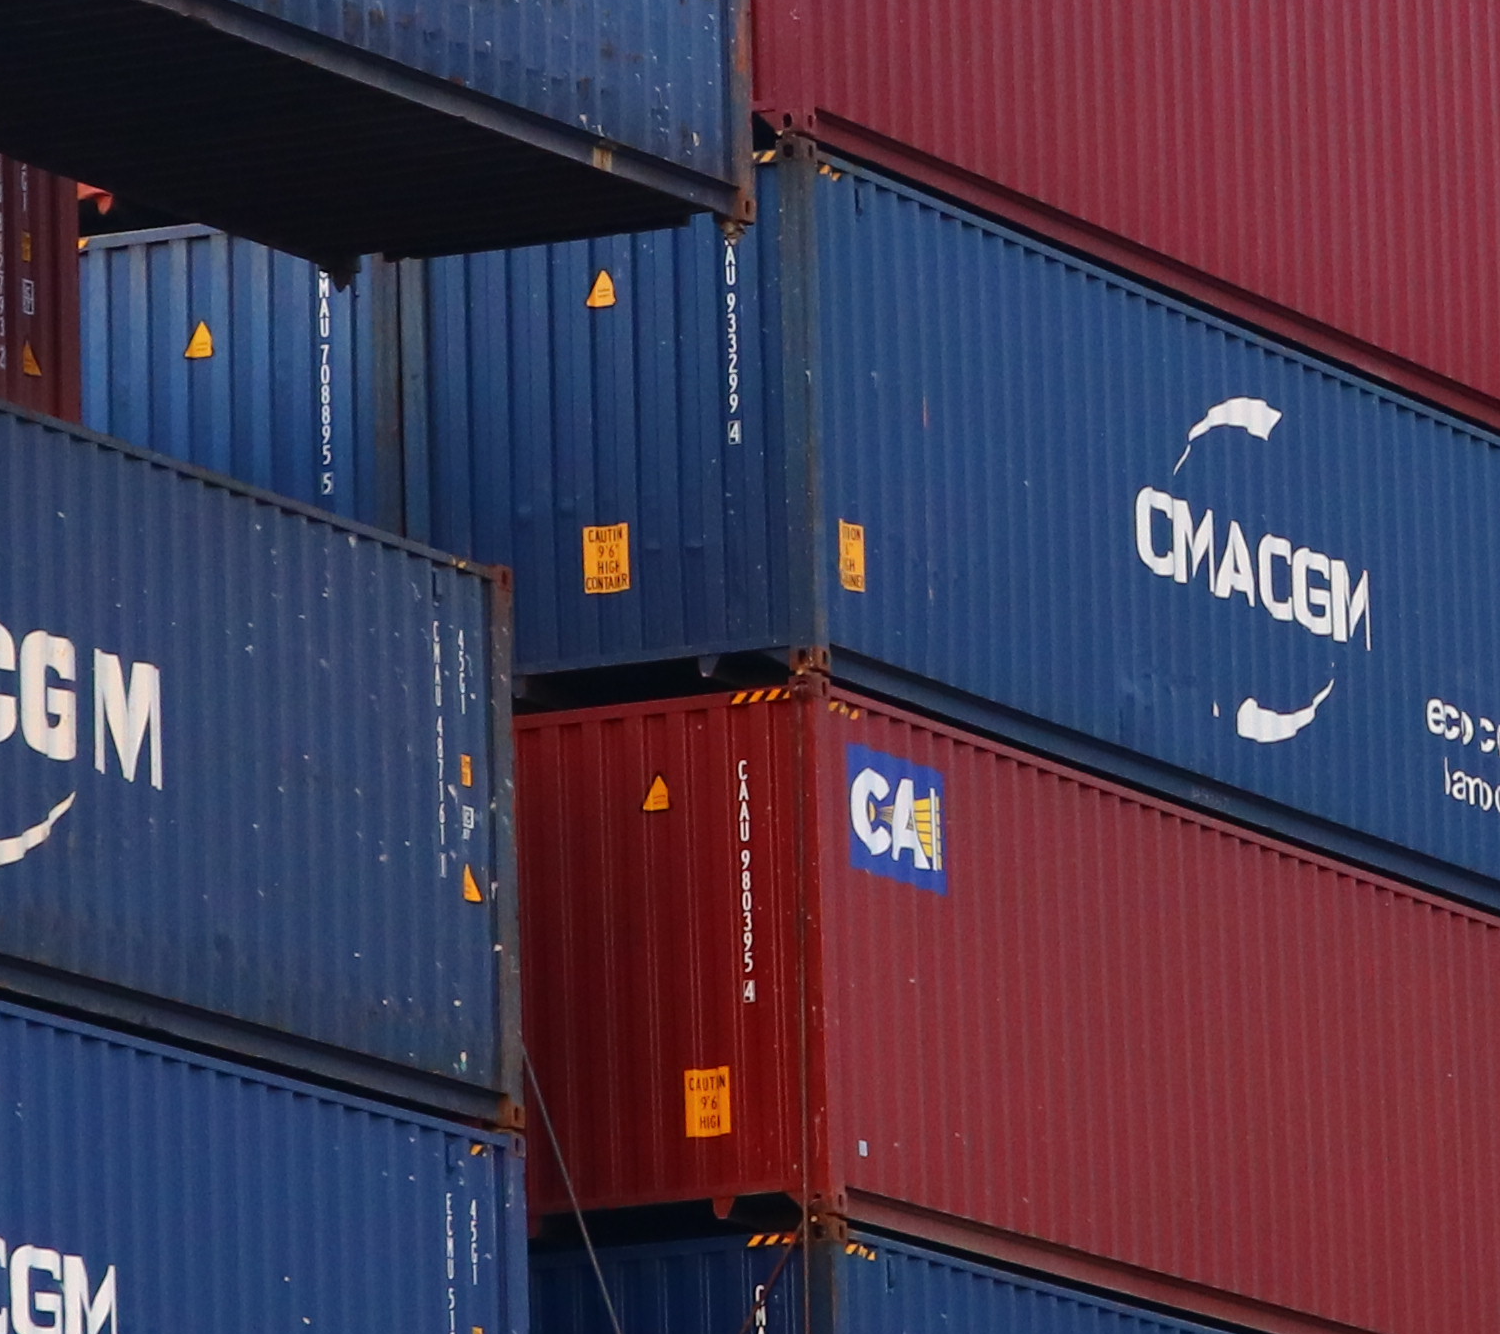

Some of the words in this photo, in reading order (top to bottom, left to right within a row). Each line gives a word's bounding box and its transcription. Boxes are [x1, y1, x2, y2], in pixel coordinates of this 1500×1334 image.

[320, 344, 333, 466] 708895
[725, 293, 740, 415] 933299
[1134, 485, 1256, 608] CMA
[1258, 533, 1372, 651] CGM
[737, 759, 750, 843] CAAU
[849, 766, 941, 872] CAI
[739, 849, 753, 974] 980395
[742, 978, 756, 1004] 4
